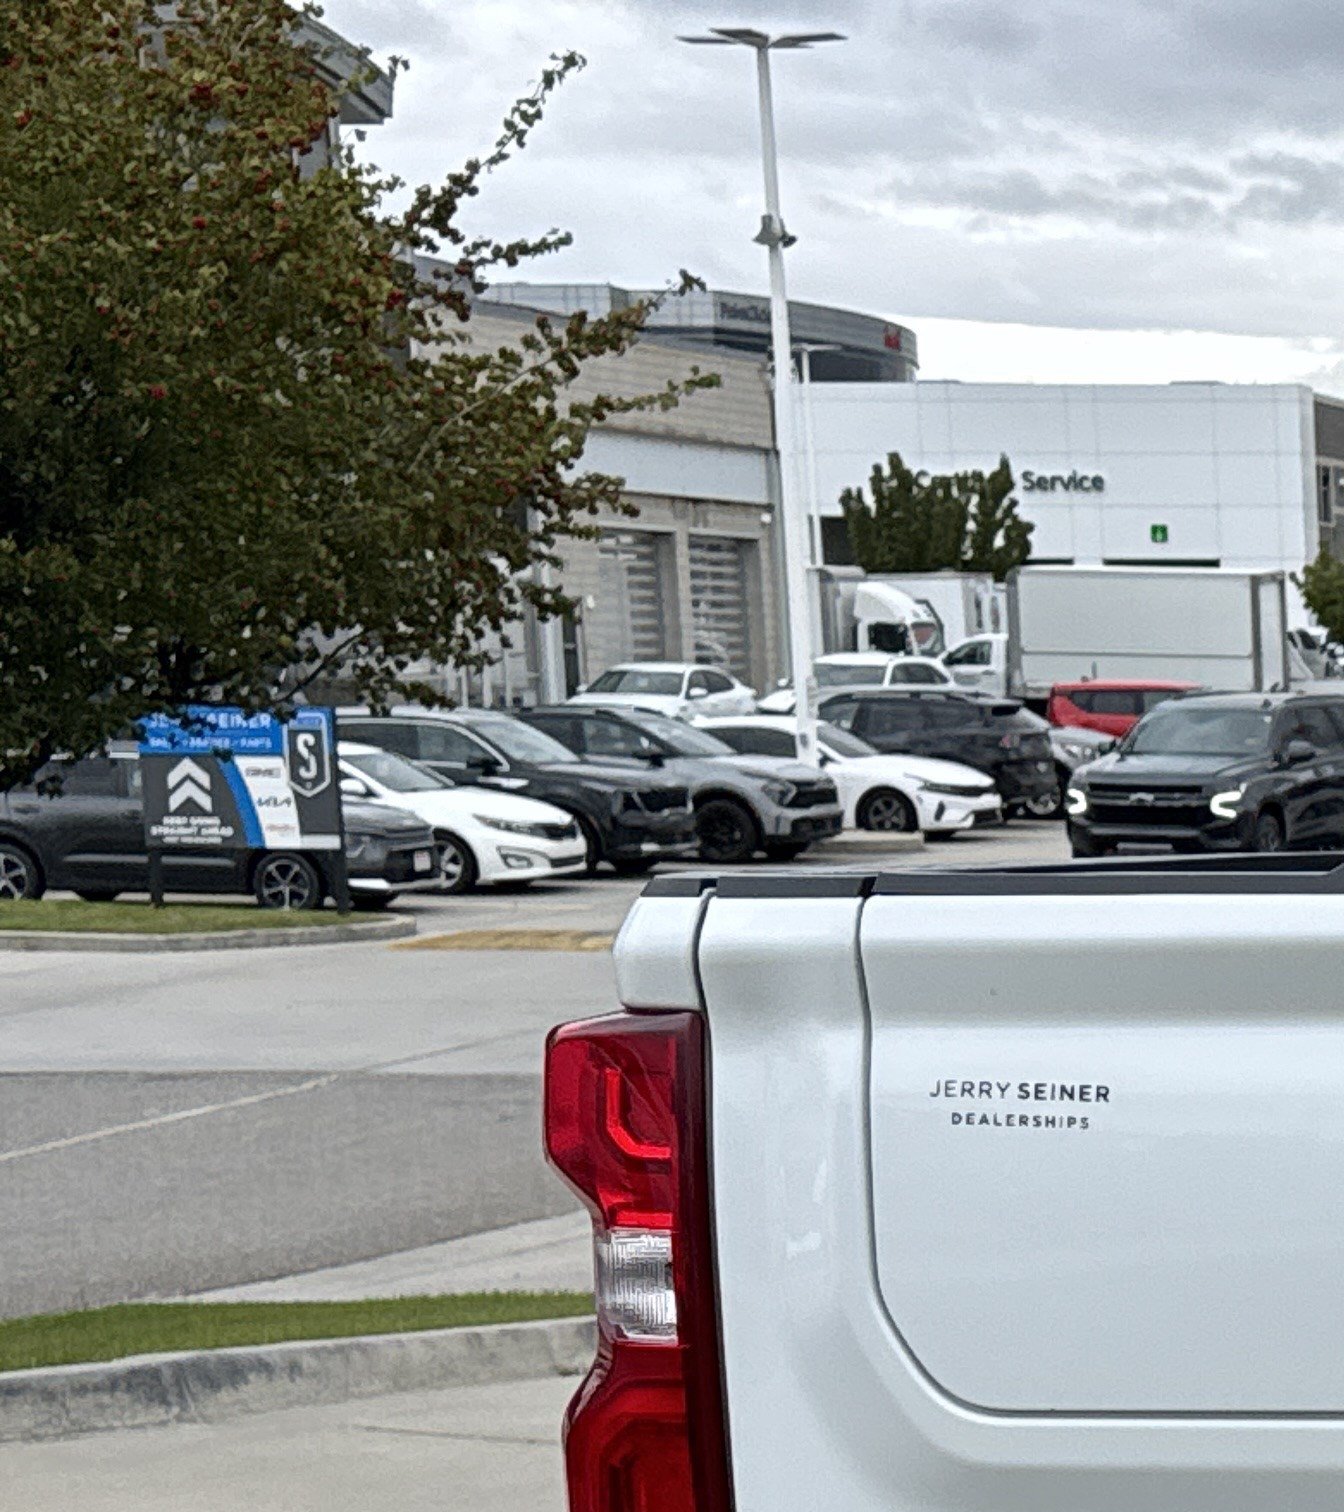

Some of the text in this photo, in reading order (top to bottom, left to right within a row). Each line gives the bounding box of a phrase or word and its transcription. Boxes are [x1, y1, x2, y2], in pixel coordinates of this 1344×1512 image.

[1021, 459, 1104, 492] Service
[930, 1079, 1111, 1103] JERRY SEINER
[951, 1112, 1090, 1130] DEALERSHIPS
